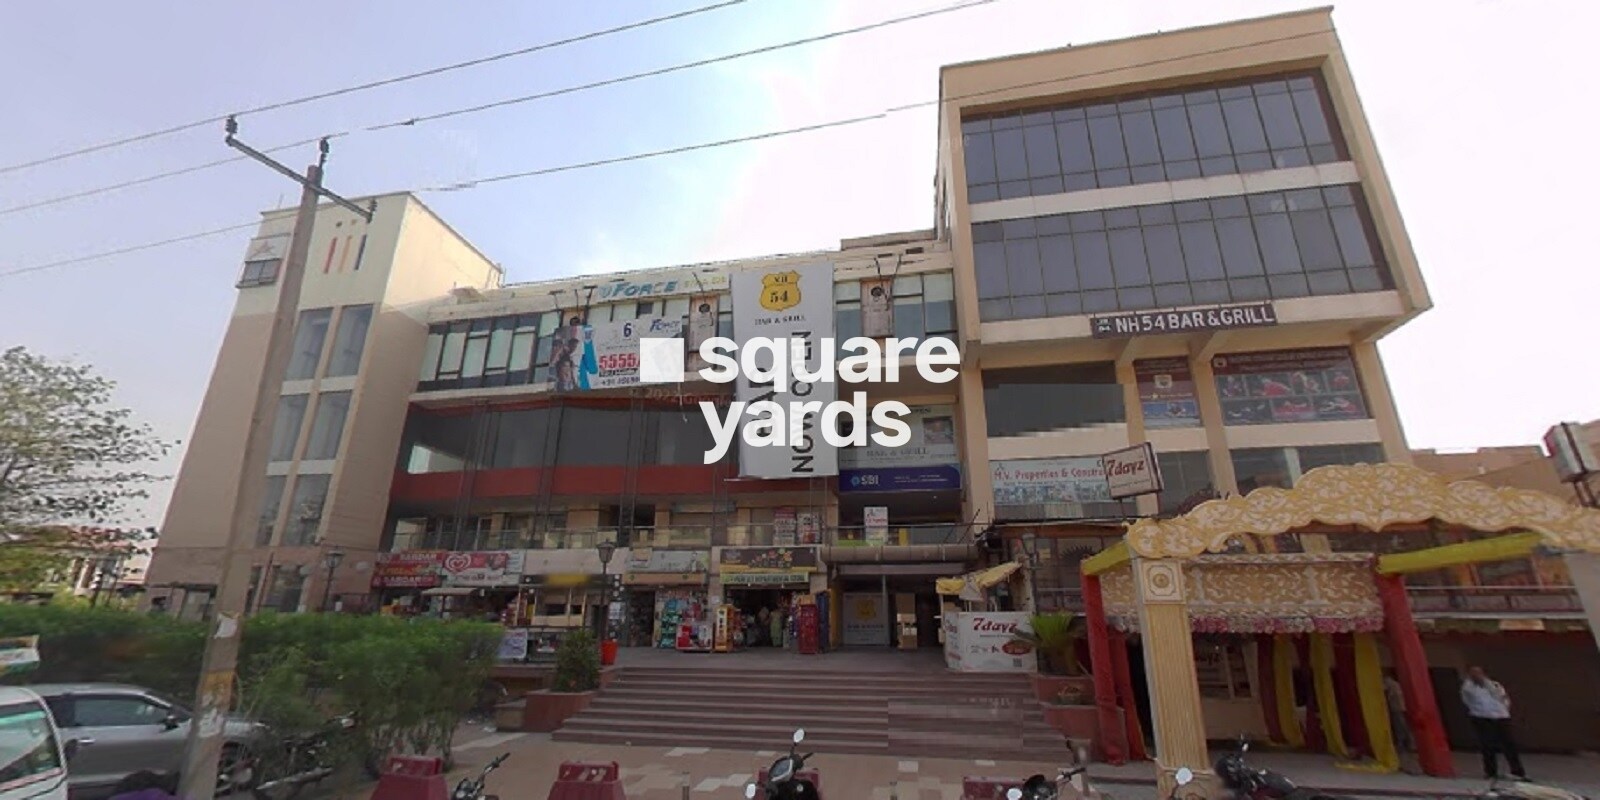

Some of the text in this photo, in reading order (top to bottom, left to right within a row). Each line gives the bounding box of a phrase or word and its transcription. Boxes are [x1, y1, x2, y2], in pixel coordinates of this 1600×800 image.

[612, 281, 678, 297] FORCE
[770, 290, 788, 303] 54
[1115, 317, 1140, 333] NH
[1142, 315, 1165, 331] 54
[1168, 311, 1206, 329] BAR
[1220, 306, 1275, 326] GRILL
[1106, 459, 1145, 477] 7dayz
[861, 475, 880, 485] SBI
